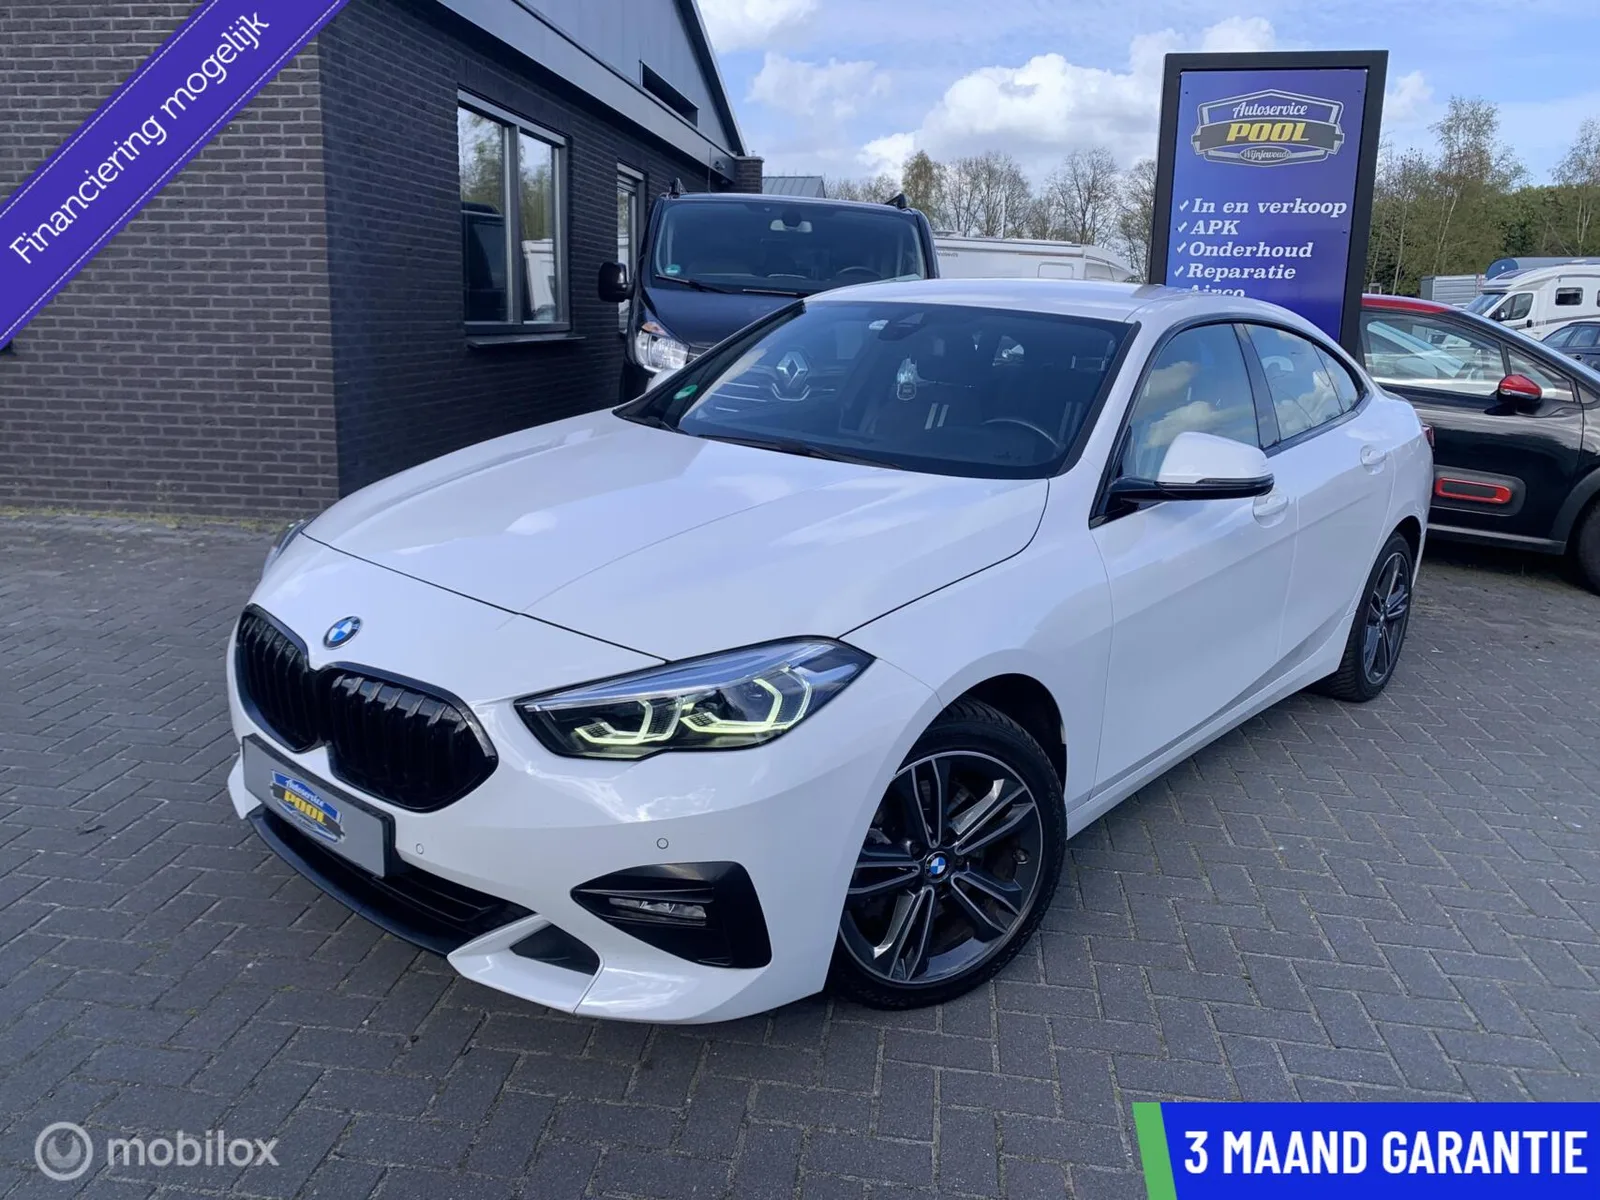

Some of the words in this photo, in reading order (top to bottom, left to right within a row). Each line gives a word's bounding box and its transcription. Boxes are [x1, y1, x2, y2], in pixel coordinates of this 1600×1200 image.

[1232, 101, 1308, 118] Autoservice
[1226, 122, 1310, 142] POOL
[1192, 198, 1216, 214] In
[1222, 201, 1249, 214] en
[1257, 198, 1347, 218] verkoop
[1190, 219, 1240, 235] APK
[1188, 242, 1313, 258] Onderhoud
[1186, 263, 1296, 282] Reparatie
[284, 790, 327, 826] POOL
